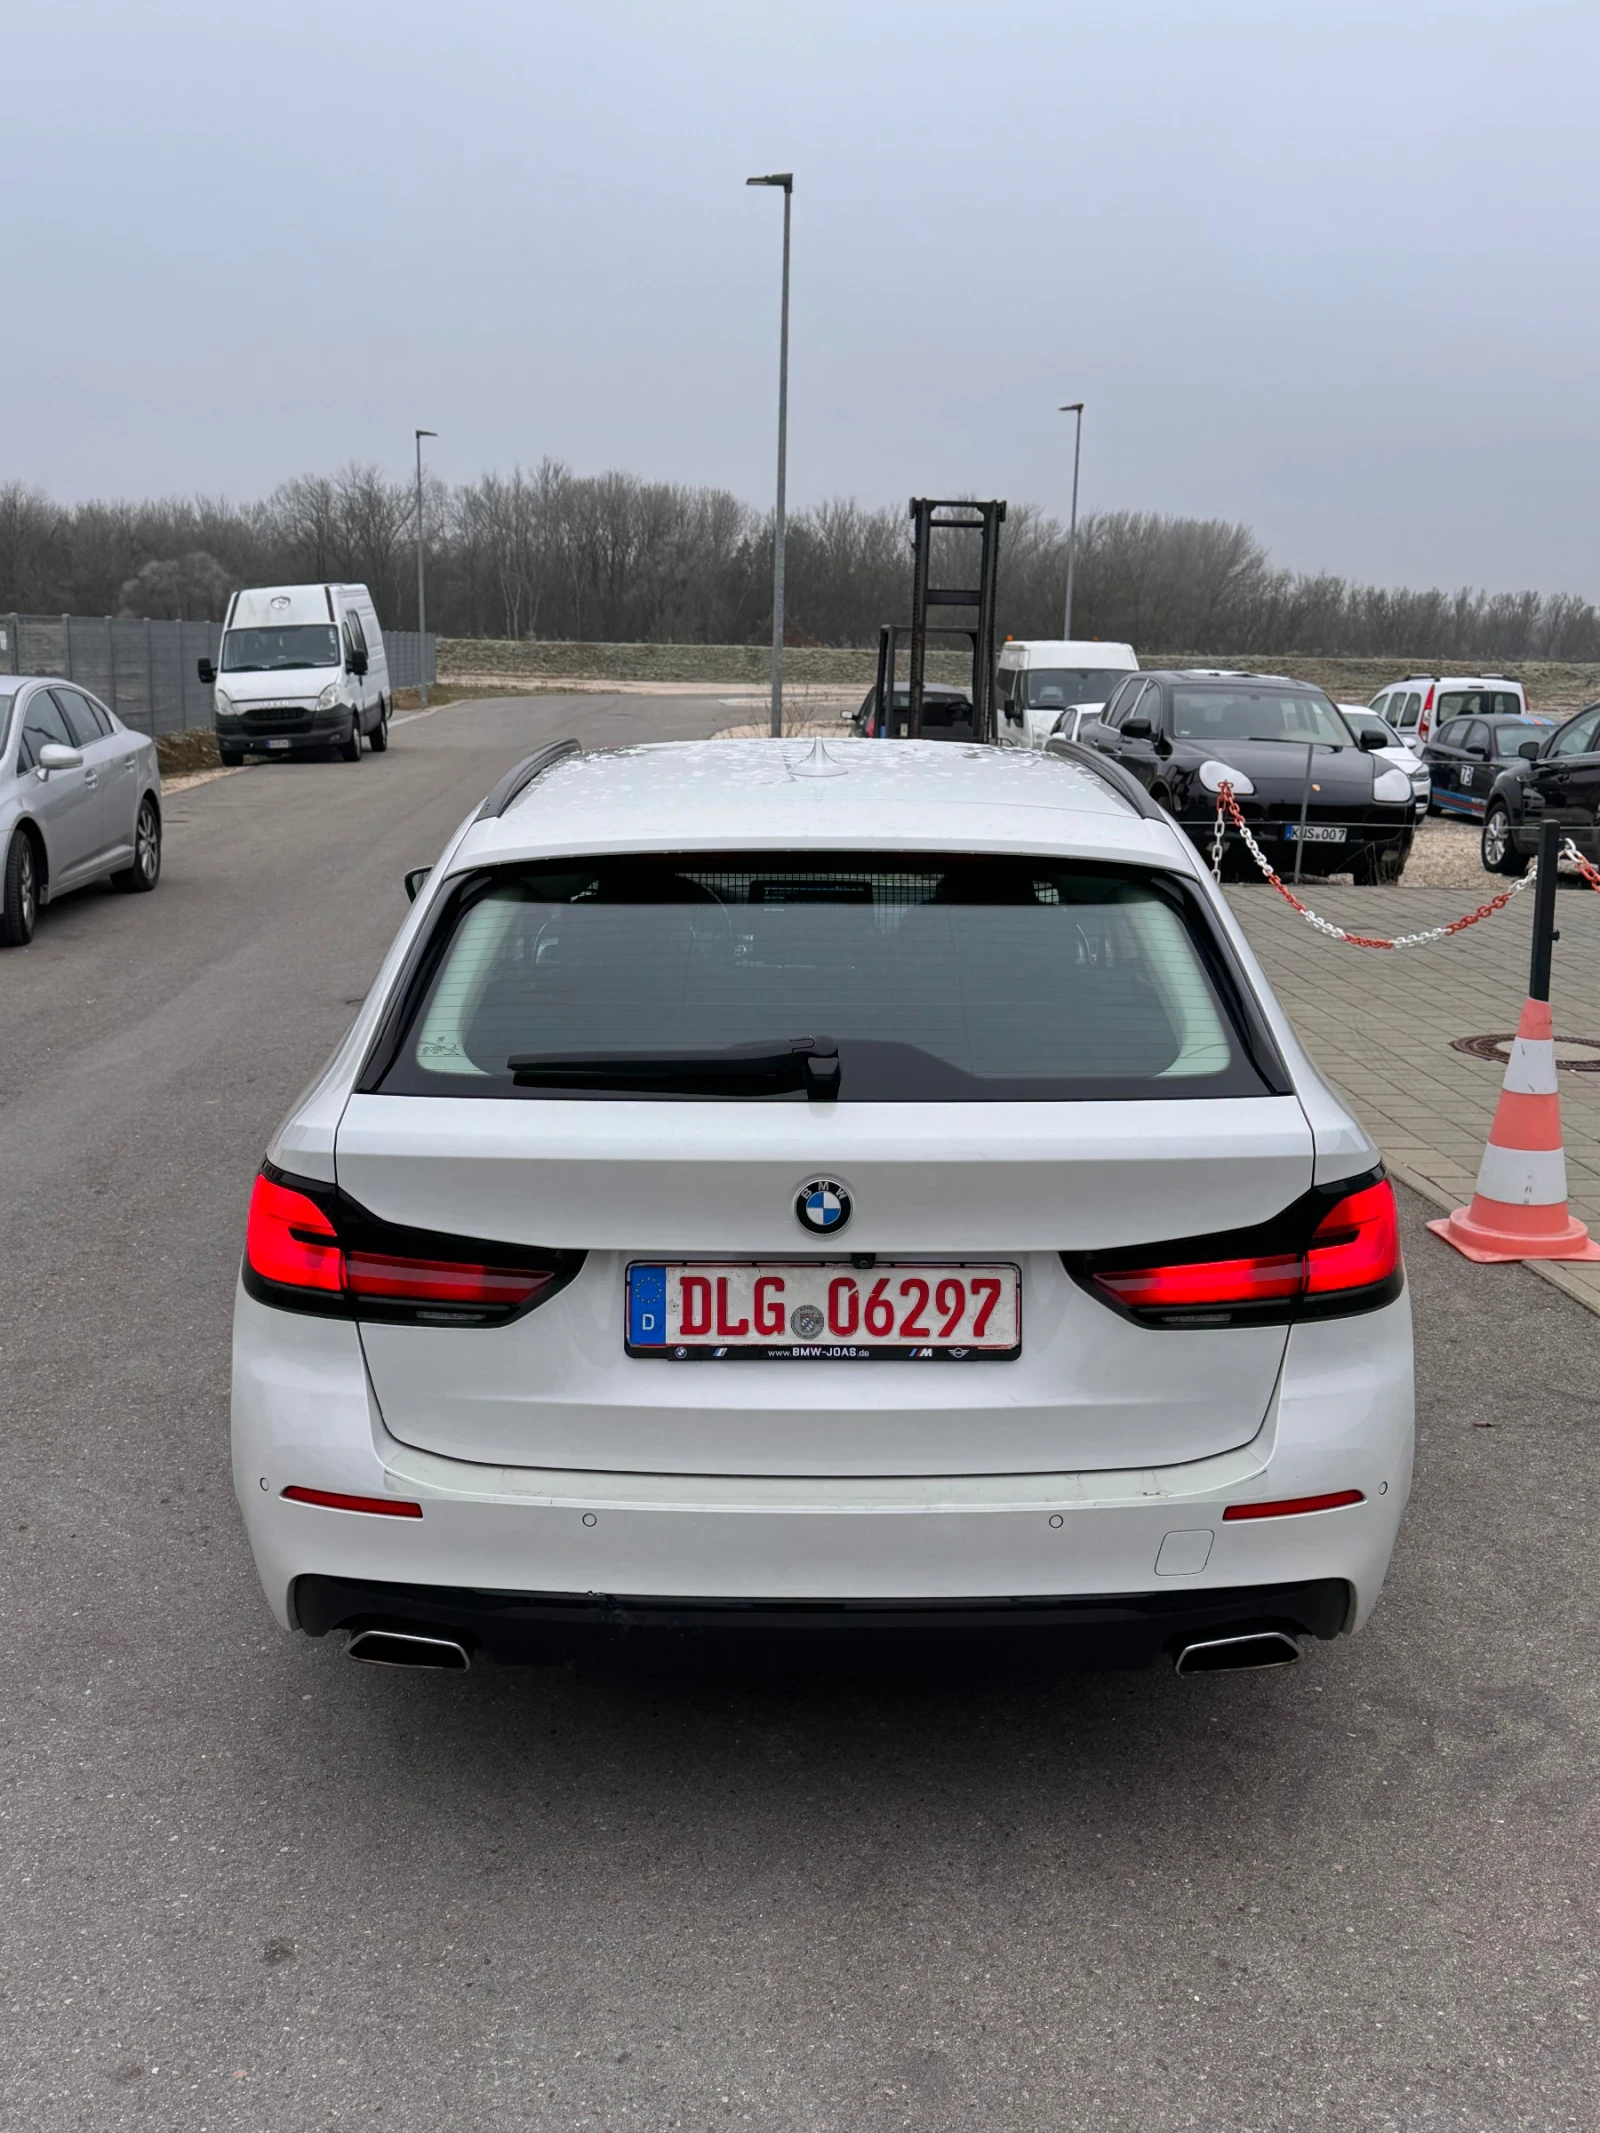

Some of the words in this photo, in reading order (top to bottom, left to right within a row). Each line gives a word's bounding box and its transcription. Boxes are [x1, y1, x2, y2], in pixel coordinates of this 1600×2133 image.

[1321, 828, 1346, 841] 007
[801, 1181, 848, 1200] BMW
[679, 1276, 785, 1336] DLG
[828, 1277, 1002, 1338] 06297
[642, 1313, 655, 1331] D
[768, 1347, 870, 1357] www.BMW-JOAS.de
